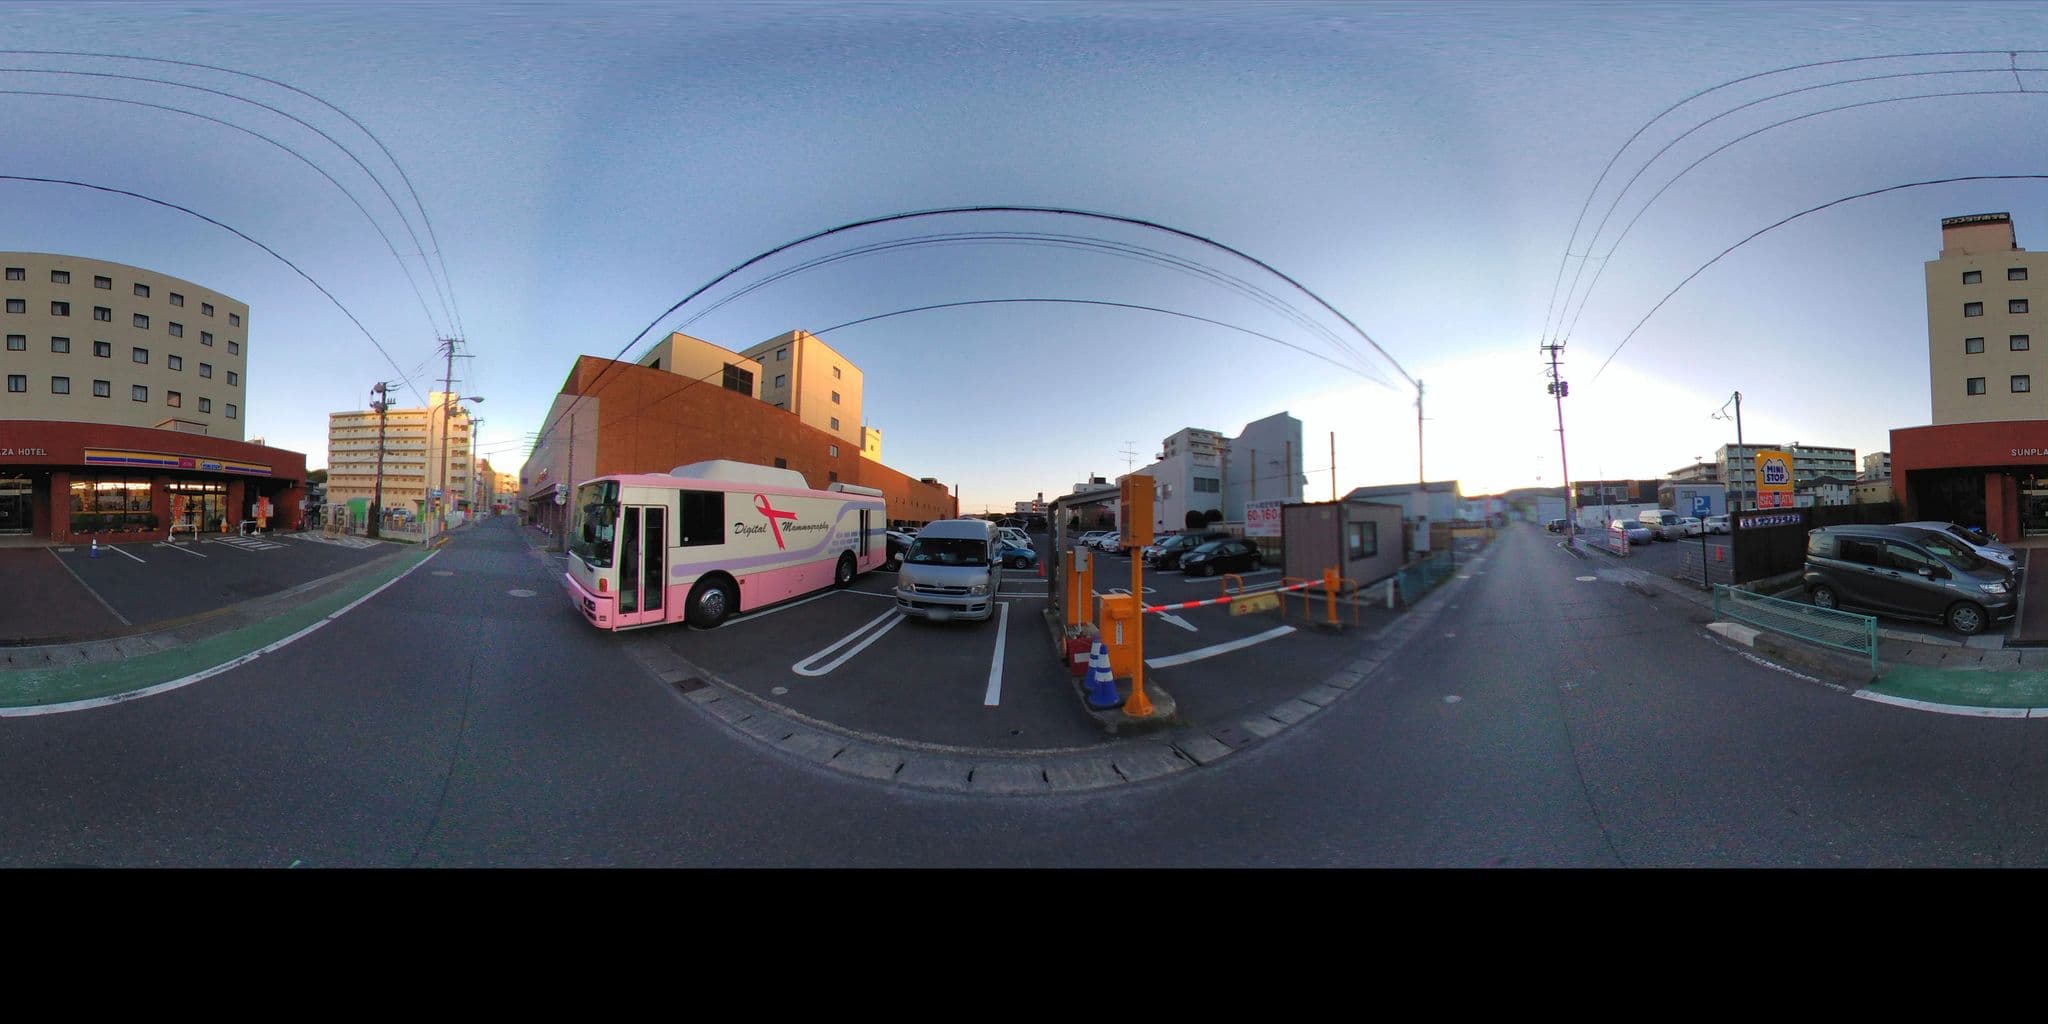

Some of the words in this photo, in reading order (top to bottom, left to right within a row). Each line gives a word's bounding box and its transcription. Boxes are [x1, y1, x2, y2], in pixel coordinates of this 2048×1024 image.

[0, 448, 15, 456] ZA
[18, 448, 47, 456] HOTEL
[1766, 465, 1784, 474] MINI
[1766, 474, 1785, 482] STOP
[1694, 497, 1705, 510] P
[734, 522, 767, 537] Digital
[781, 521, 830, 534] Mammography
